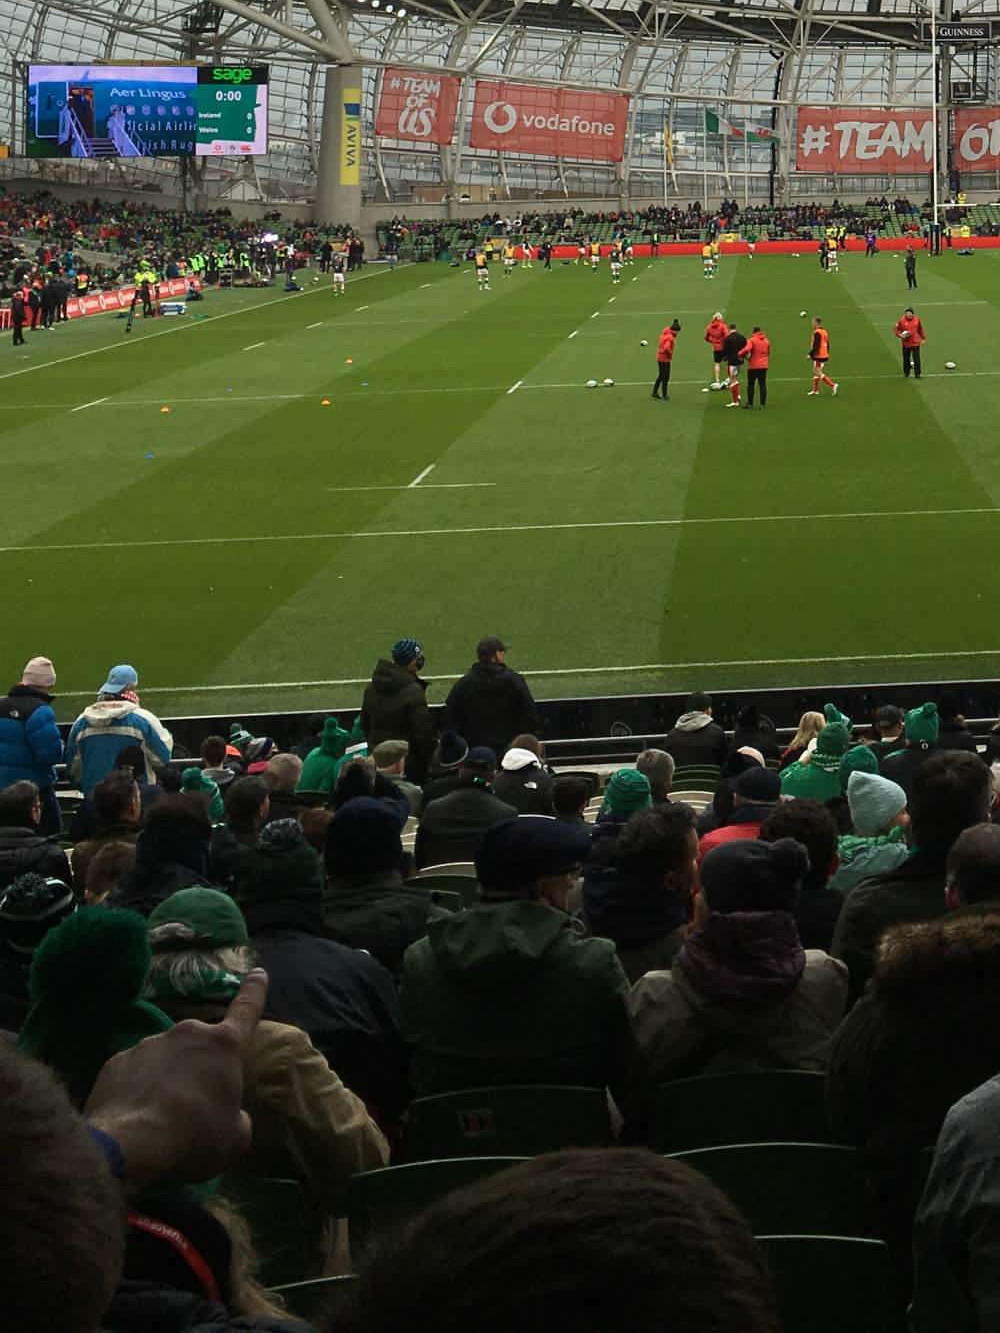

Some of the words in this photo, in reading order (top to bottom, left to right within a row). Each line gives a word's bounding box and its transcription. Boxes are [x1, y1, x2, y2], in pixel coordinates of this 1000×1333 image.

[940, 27, 985, 36] GUINNESS
[213, 68, 253, 83] sage
[110, 88, 135, 97] Aer
[138, 88, 187, 101] Lingus
[215, 90, 242, 102] 0:00
[406, 94, 430, 108] OF
[398, 106, 436, 137] US
[522, 113, 616, 136] vodafone
[346, 124, 357, 167] AVIVA
[800, 120, 934, 163] #TEAM
